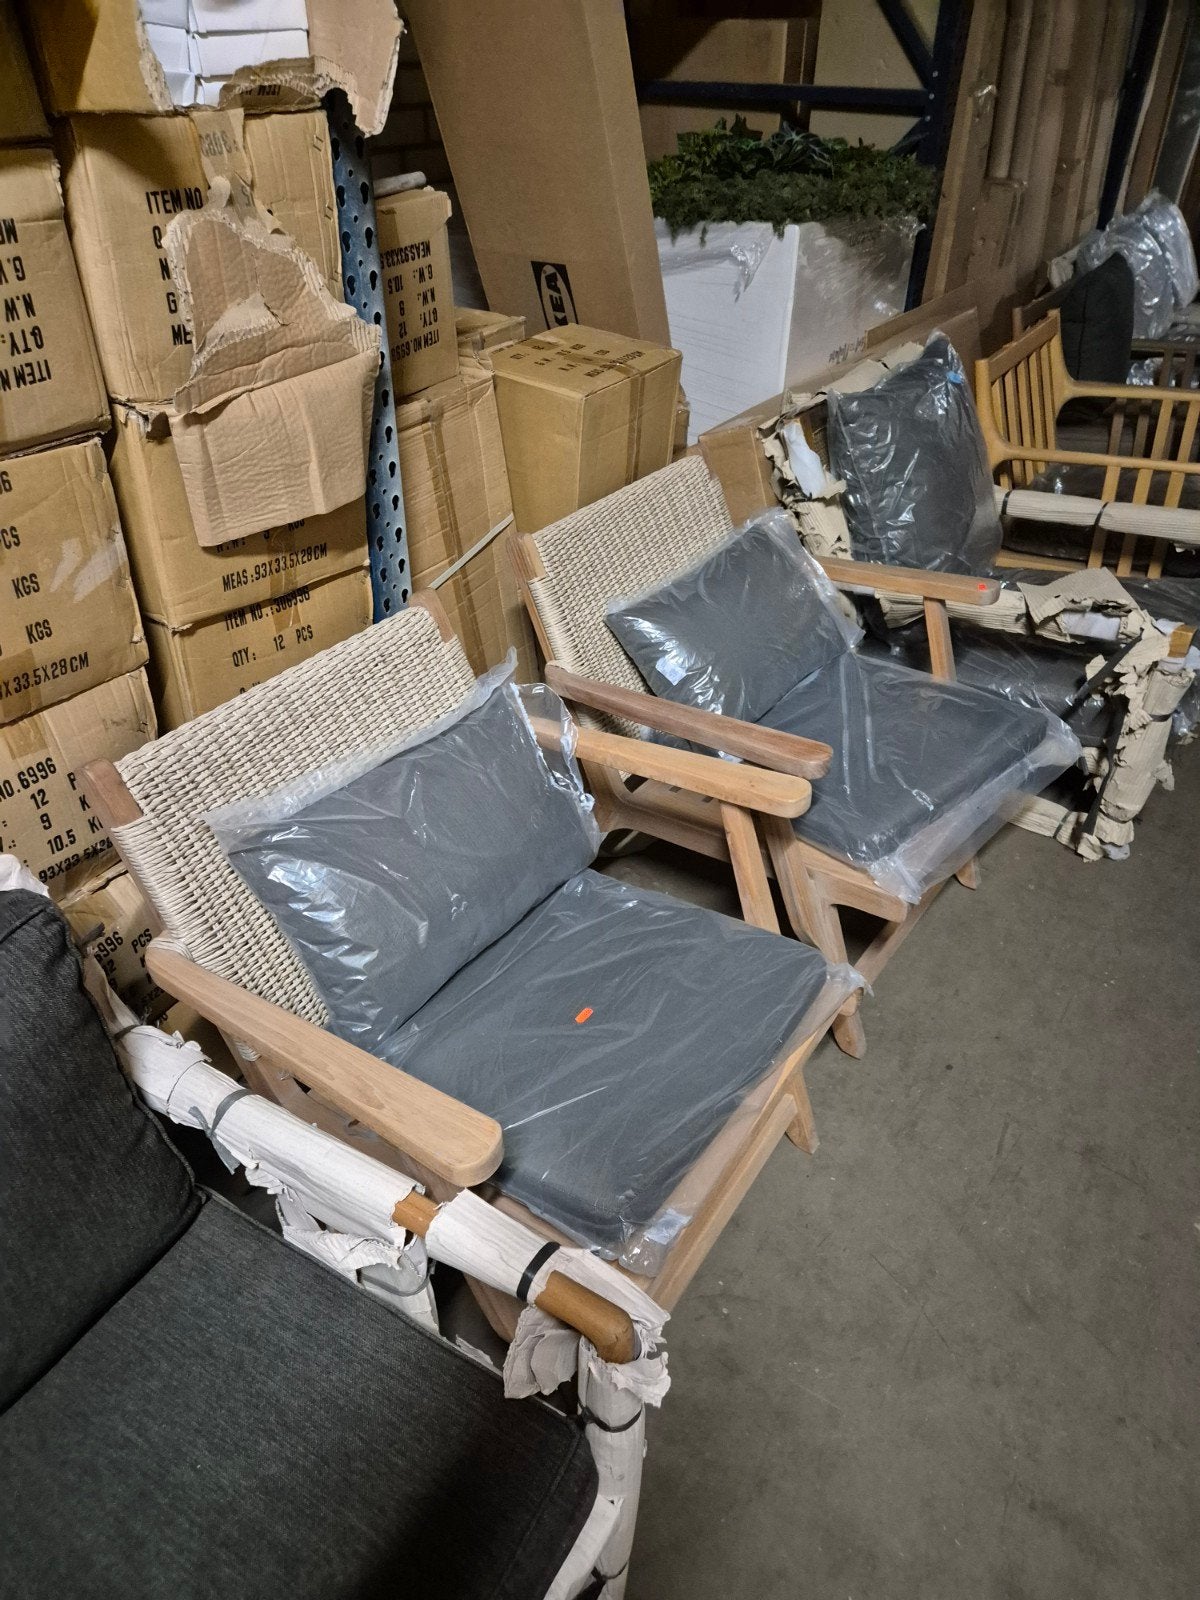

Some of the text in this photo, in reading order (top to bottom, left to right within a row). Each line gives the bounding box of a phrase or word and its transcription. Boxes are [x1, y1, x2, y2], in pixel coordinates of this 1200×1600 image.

[145, 189, 183, 214] ITEM
[544, 272, 568, 326] KEA
[0, 325, 45, 357] QTY:
[423, 329, 440, 349] ITEM
[13, 359, 52, 389] ITEM
[0, 526, 21, 550] CS
[11, 572, 41, 599] KGS
[25, 618, 53, 644] KGS
[223, 610, 248, 631] ITEM
[231, 624, 314, 668] QTY: 12 PCS
[29, 788, 50, 810] 12
[39, 812, 53, 831] 9
[46, 828, 77, 855] 10.5
[131, 928, 153, 954] PCS
